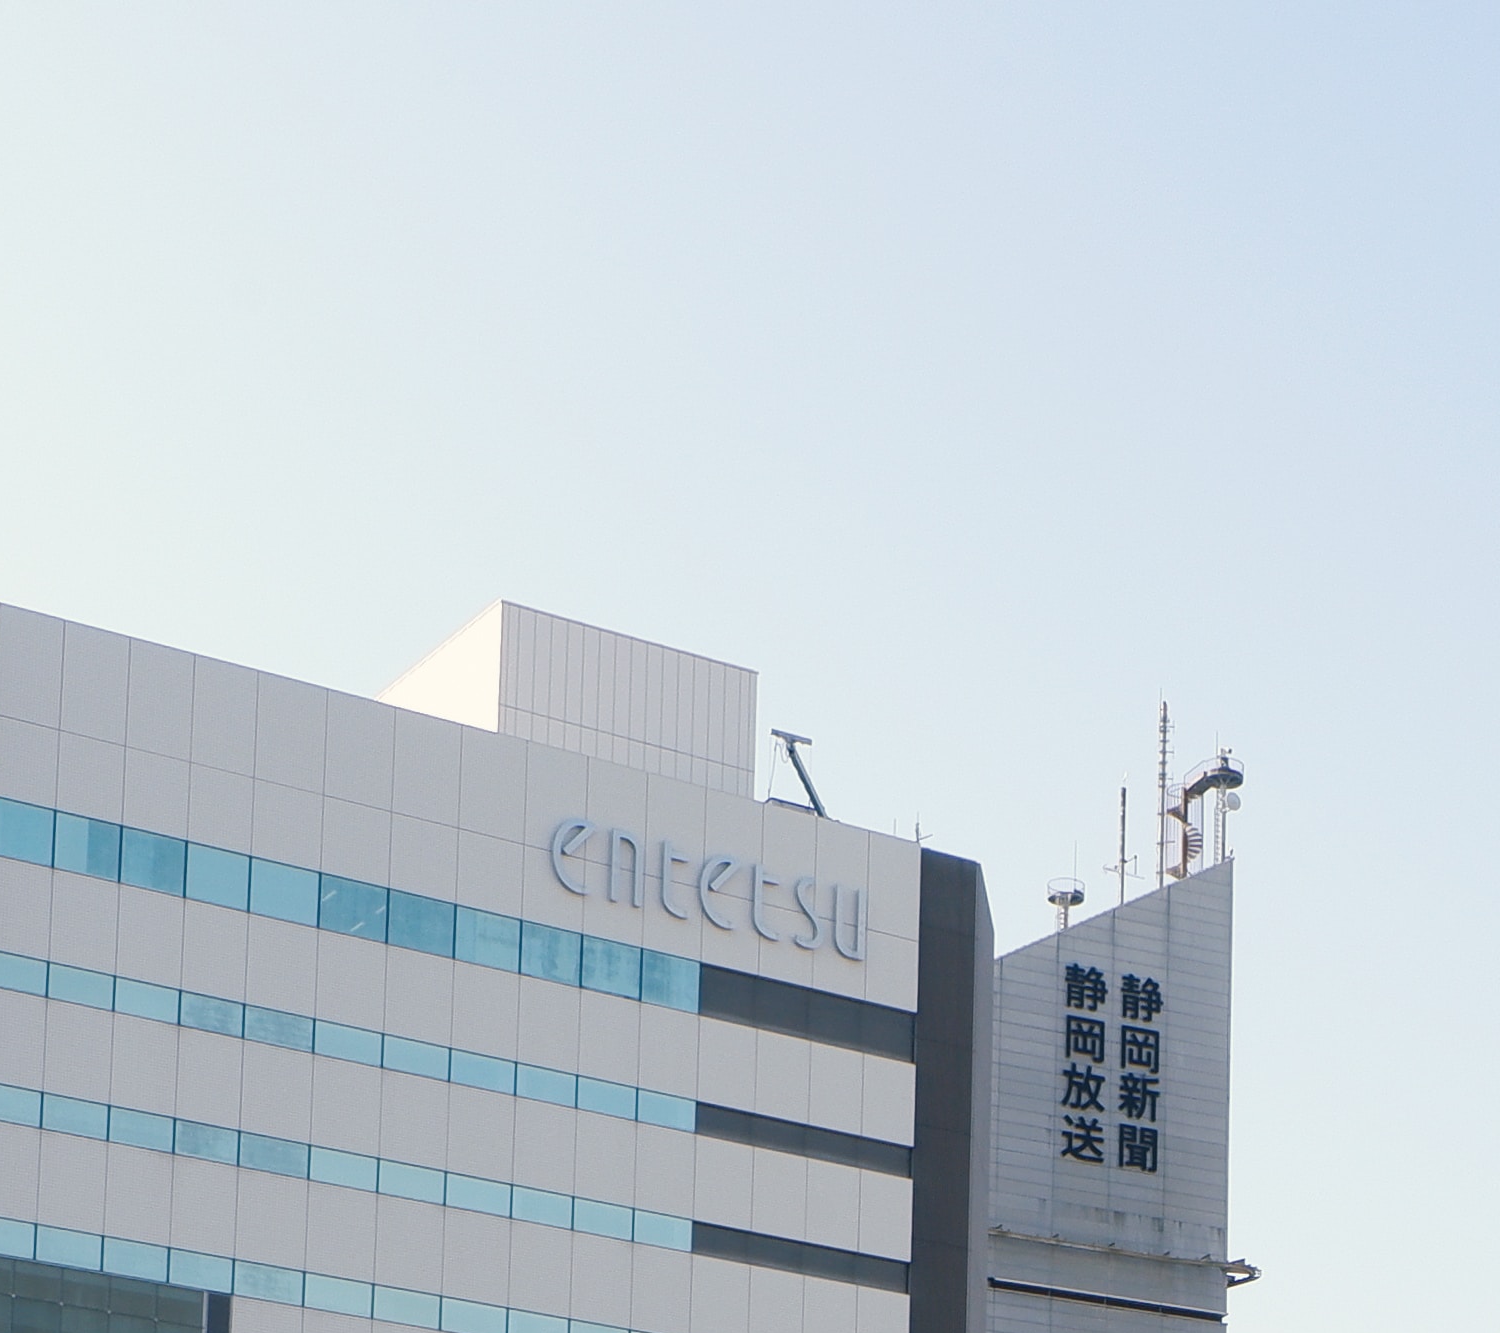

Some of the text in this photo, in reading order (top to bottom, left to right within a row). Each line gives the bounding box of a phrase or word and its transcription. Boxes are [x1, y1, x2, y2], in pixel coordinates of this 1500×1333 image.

[552, 817, 866, 962] entetsu
[1060, 963, 1108, 1165] 静岡放送
[1118, 974, 1164, 1173] 静岡新聞
